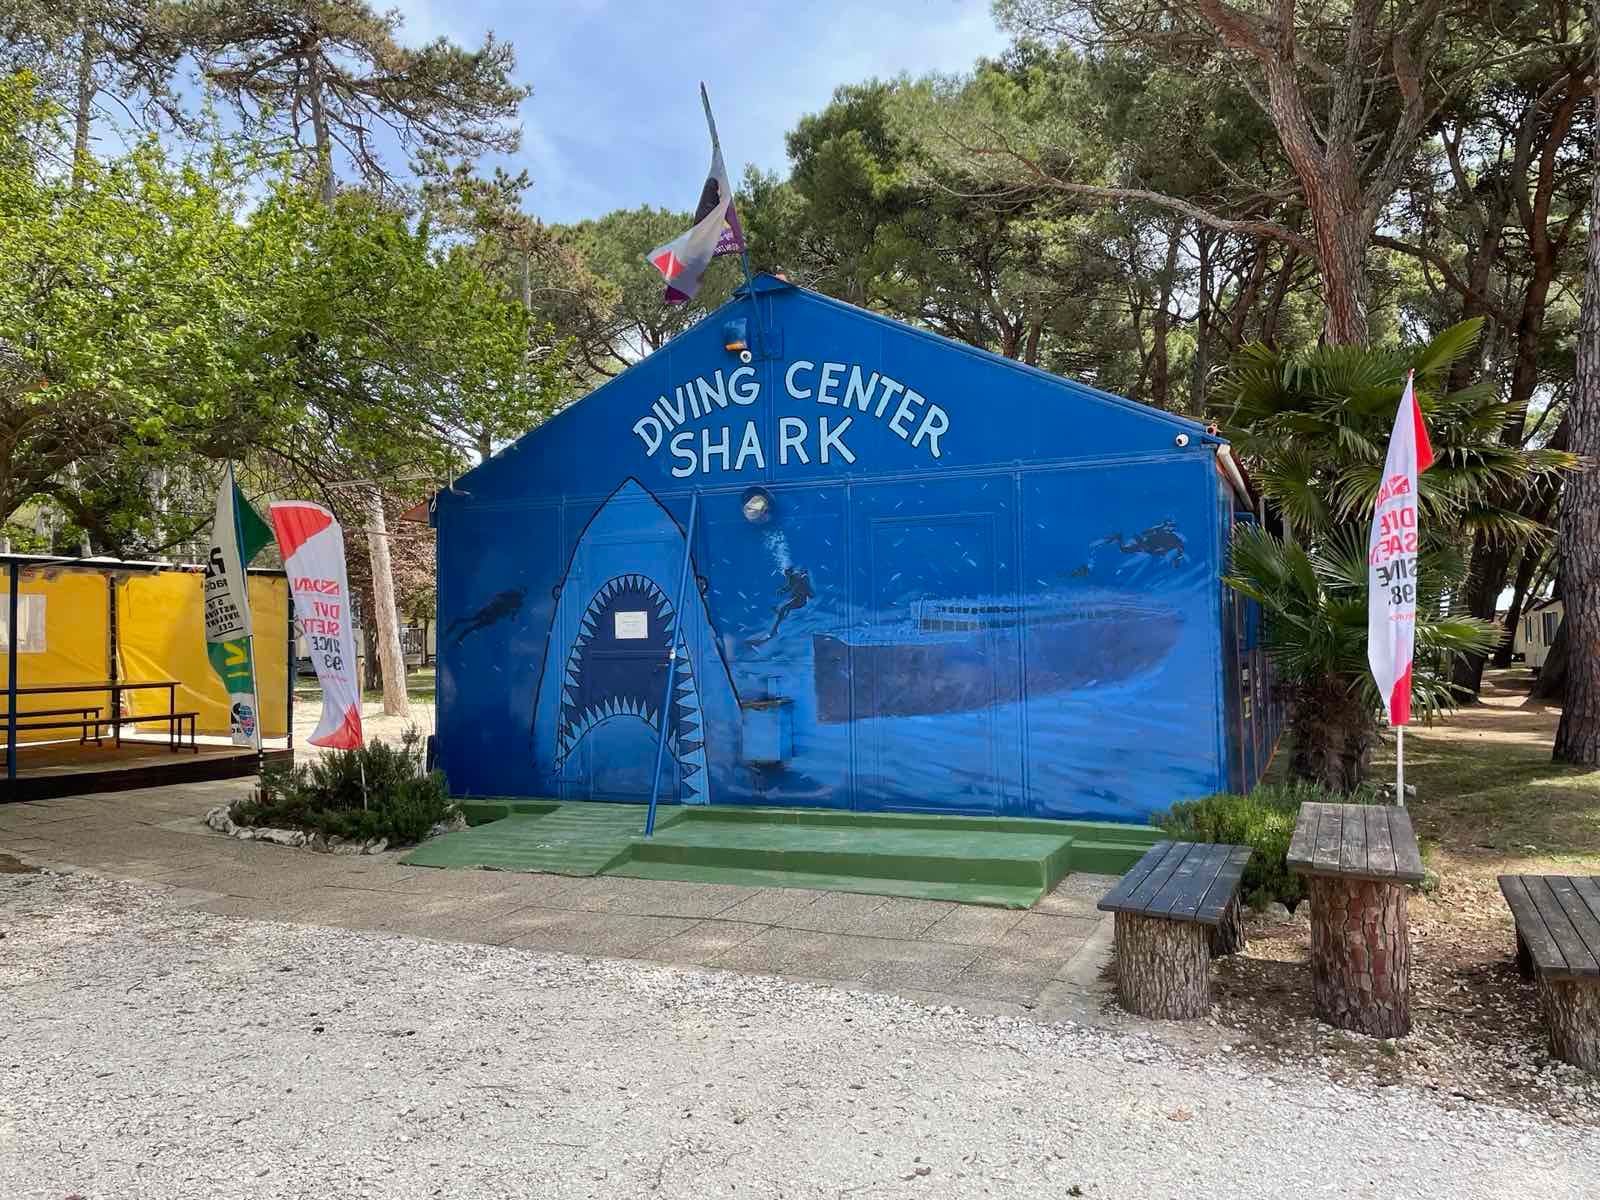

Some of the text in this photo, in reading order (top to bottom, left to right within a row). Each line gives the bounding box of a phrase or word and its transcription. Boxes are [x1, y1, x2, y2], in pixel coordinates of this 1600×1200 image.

[632, 360, 950, 458] DIVING CENTER
[670, 416, 856, 478] SHARK
